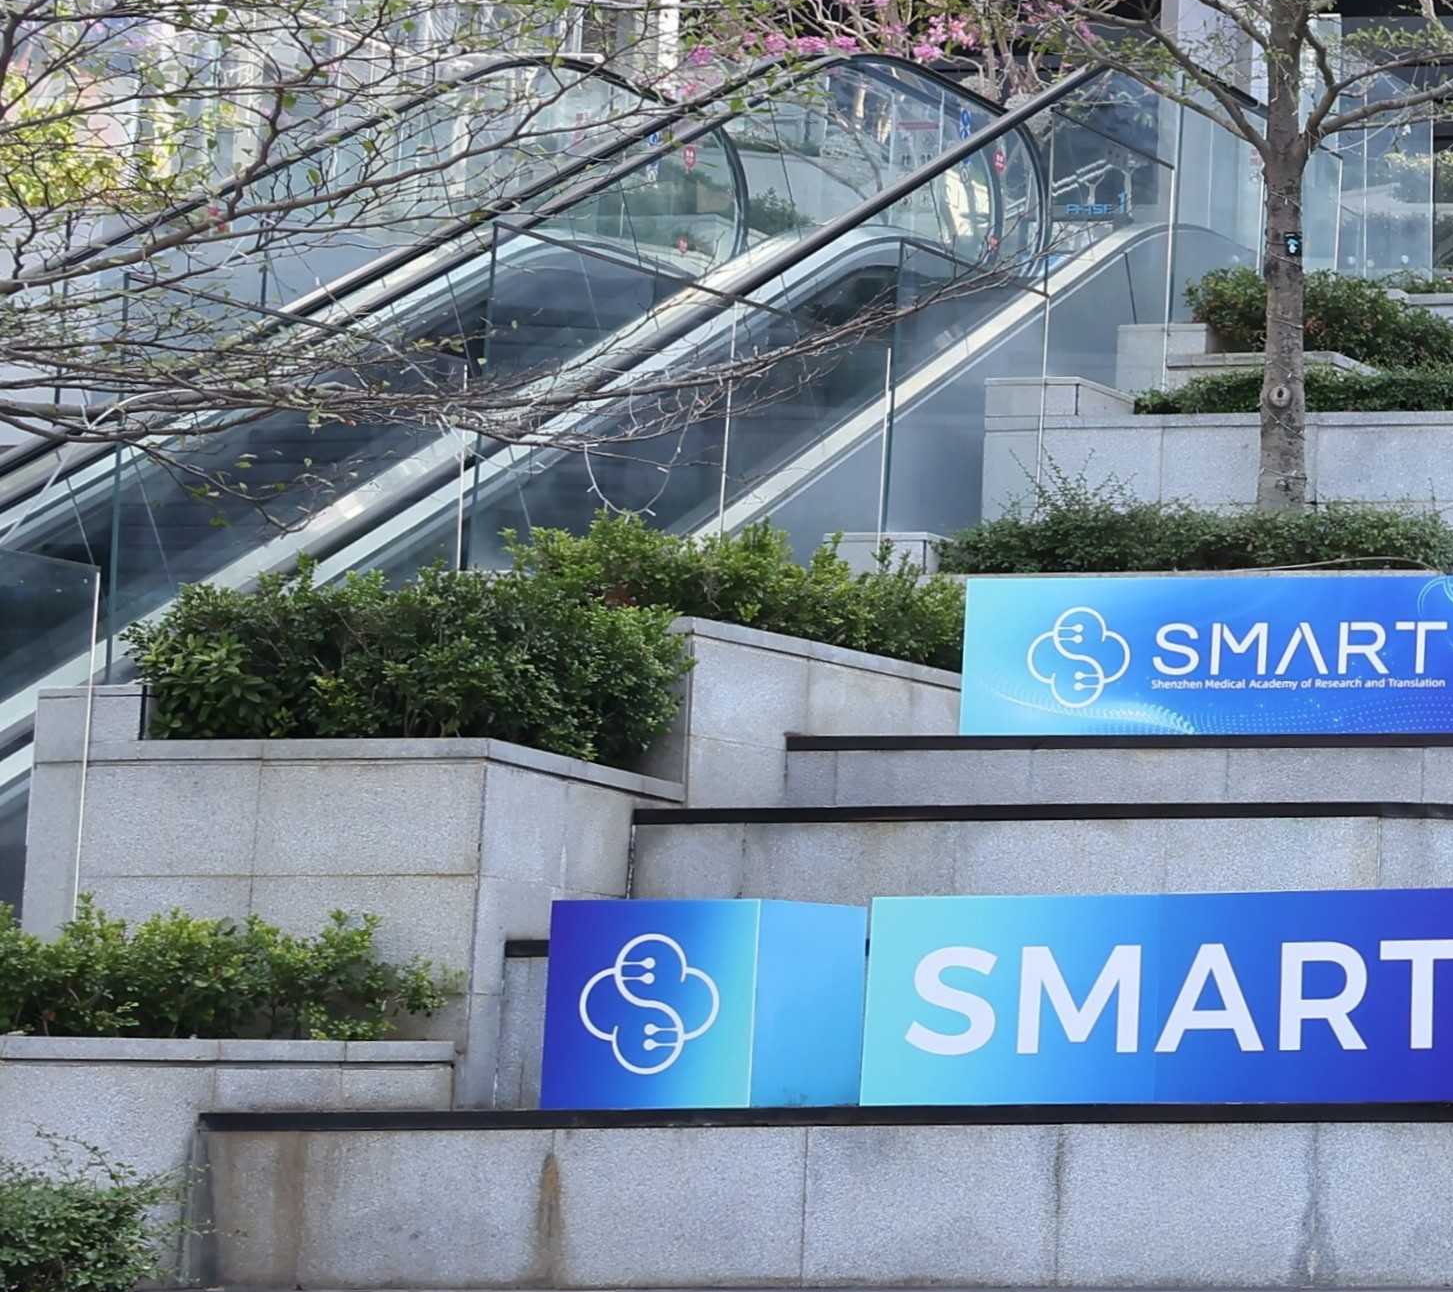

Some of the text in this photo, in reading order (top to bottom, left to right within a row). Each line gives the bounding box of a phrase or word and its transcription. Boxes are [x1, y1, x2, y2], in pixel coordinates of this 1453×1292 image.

[1152, 622, 1448, 675] SMART
[1151, 677, 1446, 691] Shenzhen Medical Academy of Research and Translation
